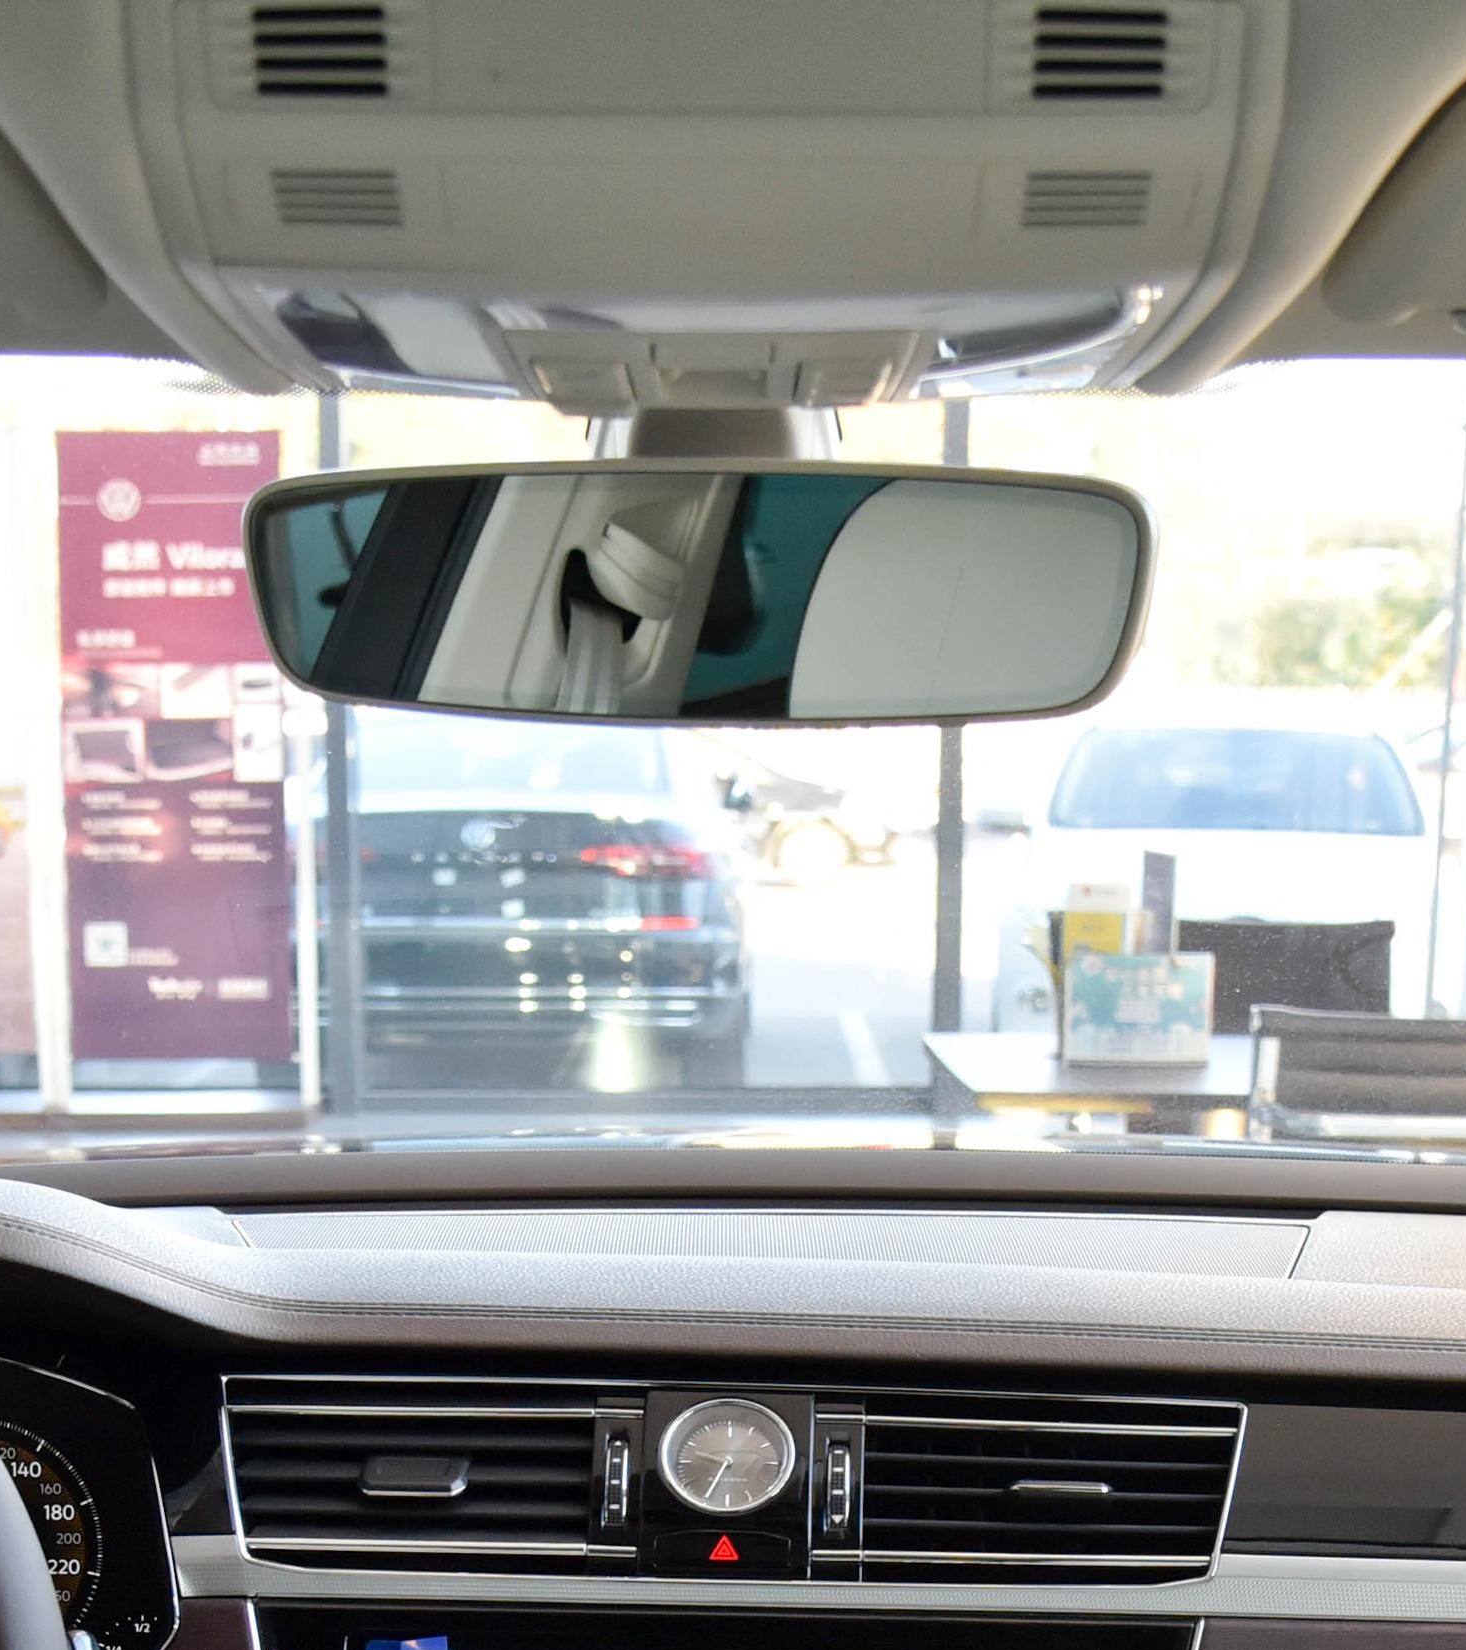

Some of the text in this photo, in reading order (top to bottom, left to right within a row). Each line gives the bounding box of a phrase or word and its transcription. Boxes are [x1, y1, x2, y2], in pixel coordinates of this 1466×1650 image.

[10, 1461, 42, 1478] 140
[39, 1483, 62, 1496] 160
[44, 1504, 75, 1521] 180
[56, 1532, 82, 1546] 200
[48, 1559, 81, 1576] 220
[134, 1622, 151, 1634] 1/2
